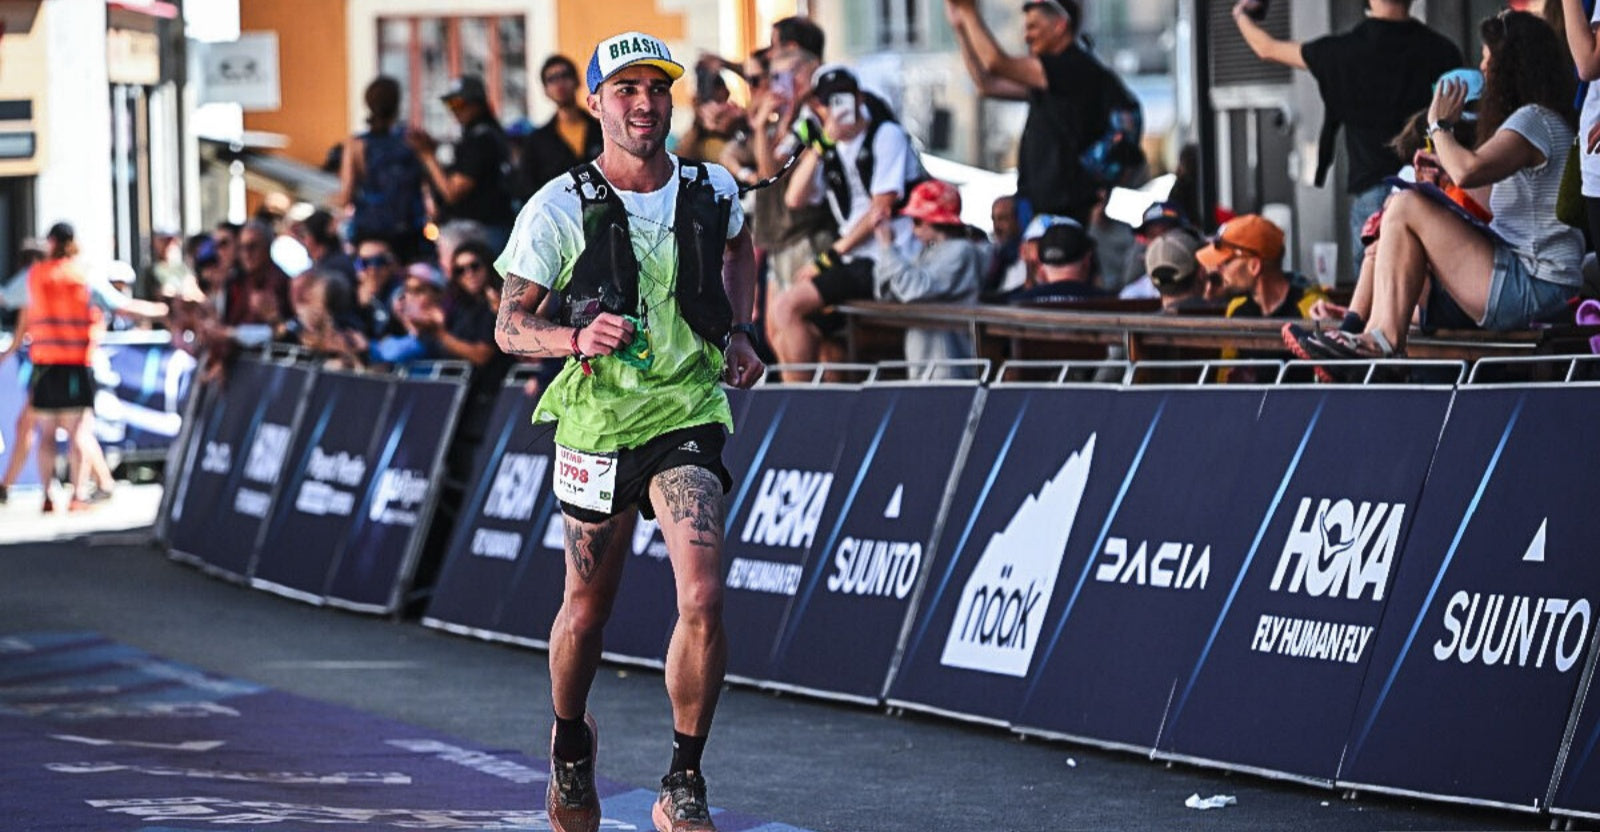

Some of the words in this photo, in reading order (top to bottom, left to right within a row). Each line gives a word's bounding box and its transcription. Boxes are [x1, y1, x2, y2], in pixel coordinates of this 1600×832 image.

[608, 36, 665, 60] BRASIL
[559, 461, 589, 484] 1798
[741, 468, 834, 548] HOKA
[827, 536, 922, 599] SUUNTO
[1096, 537, 1210, 590] DACIA
[1269, 497, 1406, 601] HOKA
[1251, 614, 1286, 653] FLY
[1277, 618, 1346, 662] HUMAN
[1346, 625, 1374, 663] FLY
[1433, 590, 1592, 672] SUUNTO
